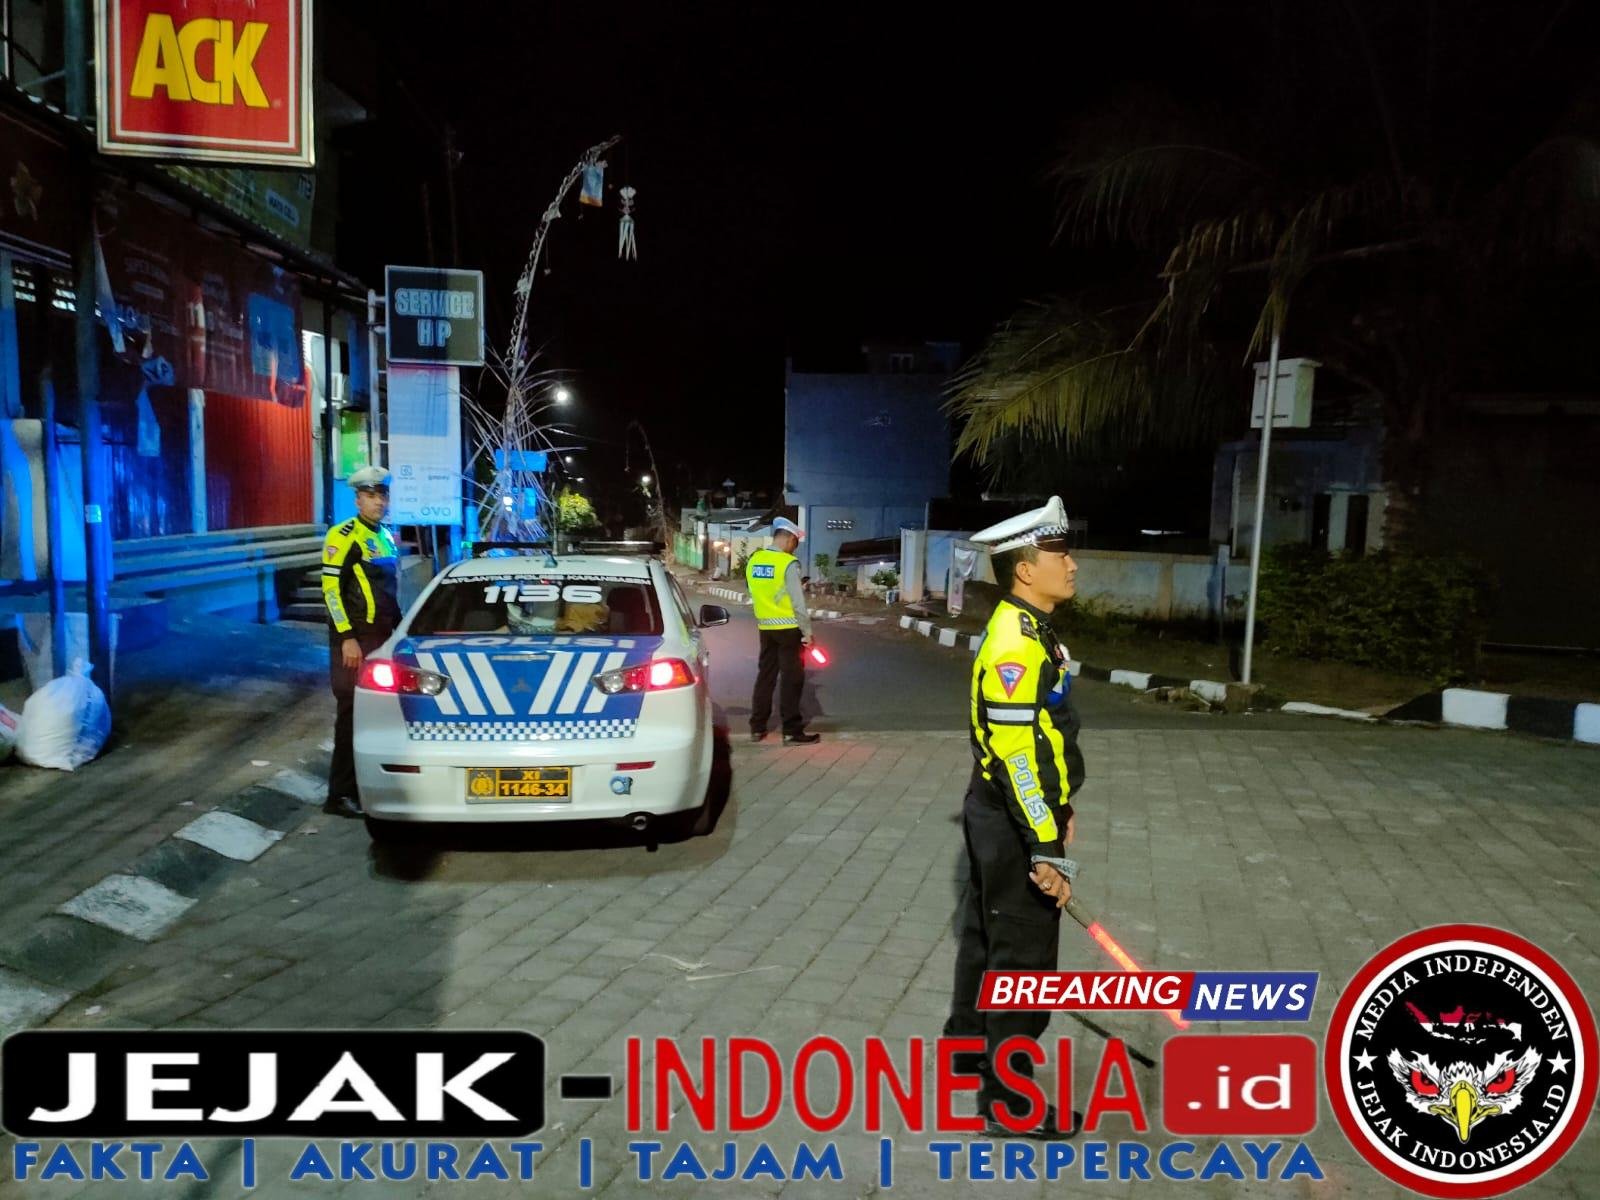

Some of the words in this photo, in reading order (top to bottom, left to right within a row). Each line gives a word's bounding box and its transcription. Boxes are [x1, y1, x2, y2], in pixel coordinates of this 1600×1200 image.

[130, 13, 270, 108] ACK
[395, 287, 475, 319] SERVICE
[417, 318, 452, 347] HP
[421, 506, 452, 516] OVO
[484, 585, 602, 604] 1136
[418, 637, 636, 649] POLISI
[522, 770, 541, 780] XI
[501, 782, 565, 796] 1146-34
[1008, 753, 1048, 825] POLISI
